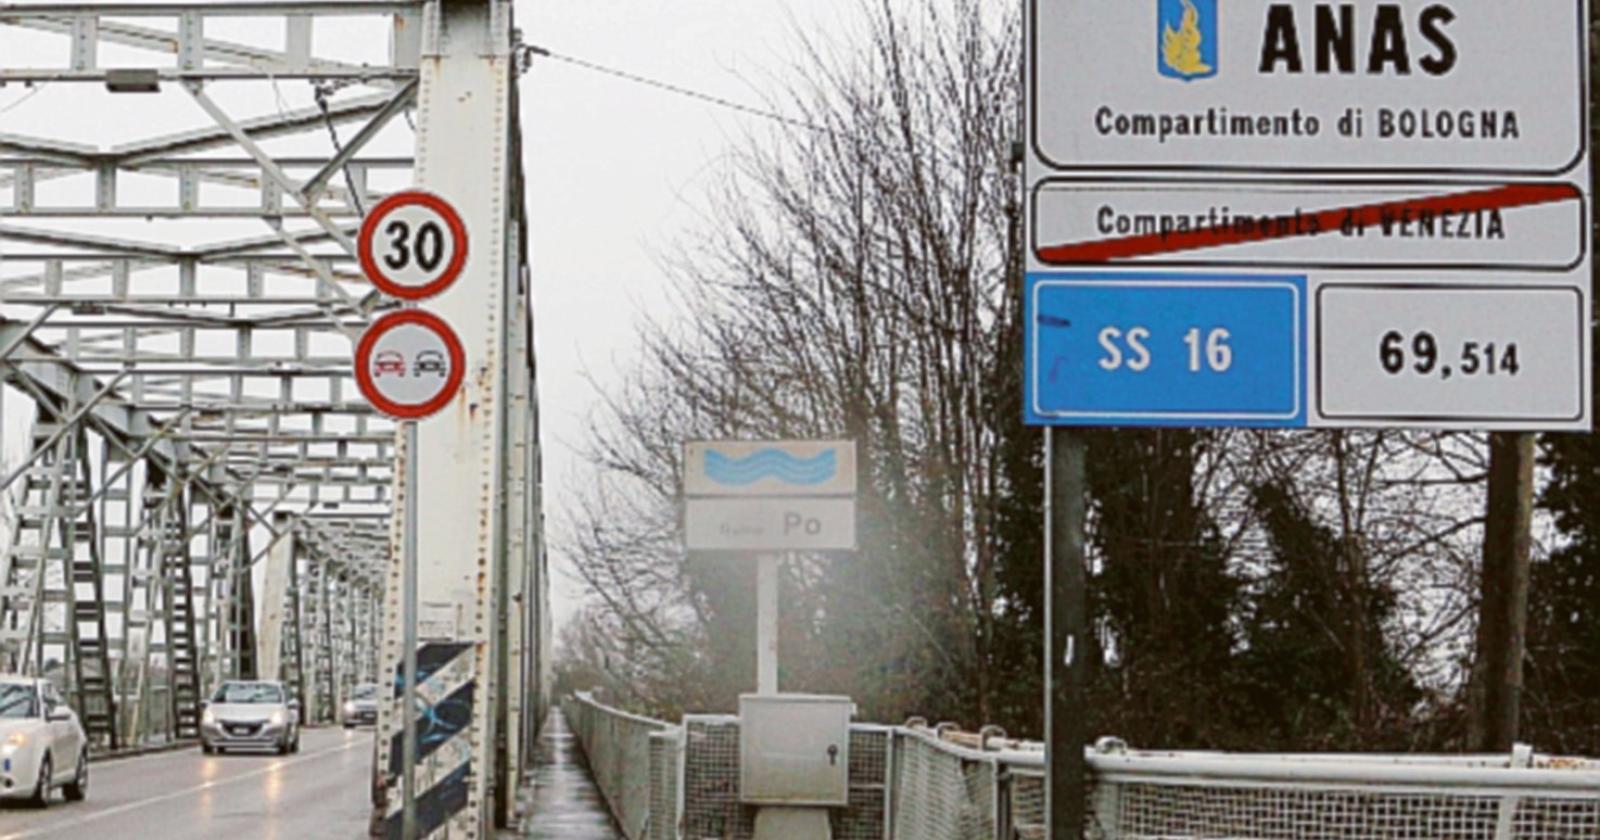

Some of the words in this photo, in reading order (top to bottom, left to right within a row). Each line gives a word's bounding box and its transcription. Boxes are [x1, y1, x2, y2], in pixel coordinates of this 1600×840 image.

[1259, 3, 1457, 76] ANAS
[1095, 107, 1321, 142] Compartimento
[1337, 107, 1364, 138] di
[1378, 109, 1520, 139] BOLOGNA
[1096, 205, 1322, 241] Compartimento
[1381, 208, 1505, 239] VENEZIA
[384, 219, 444, 272] 30
[1097, 327, 1150, 371] SS
[1183, 328, 1233, 371] 16
[1379, 330, 1520, 381] 69,514
[783, 511, 822, 536] Po
